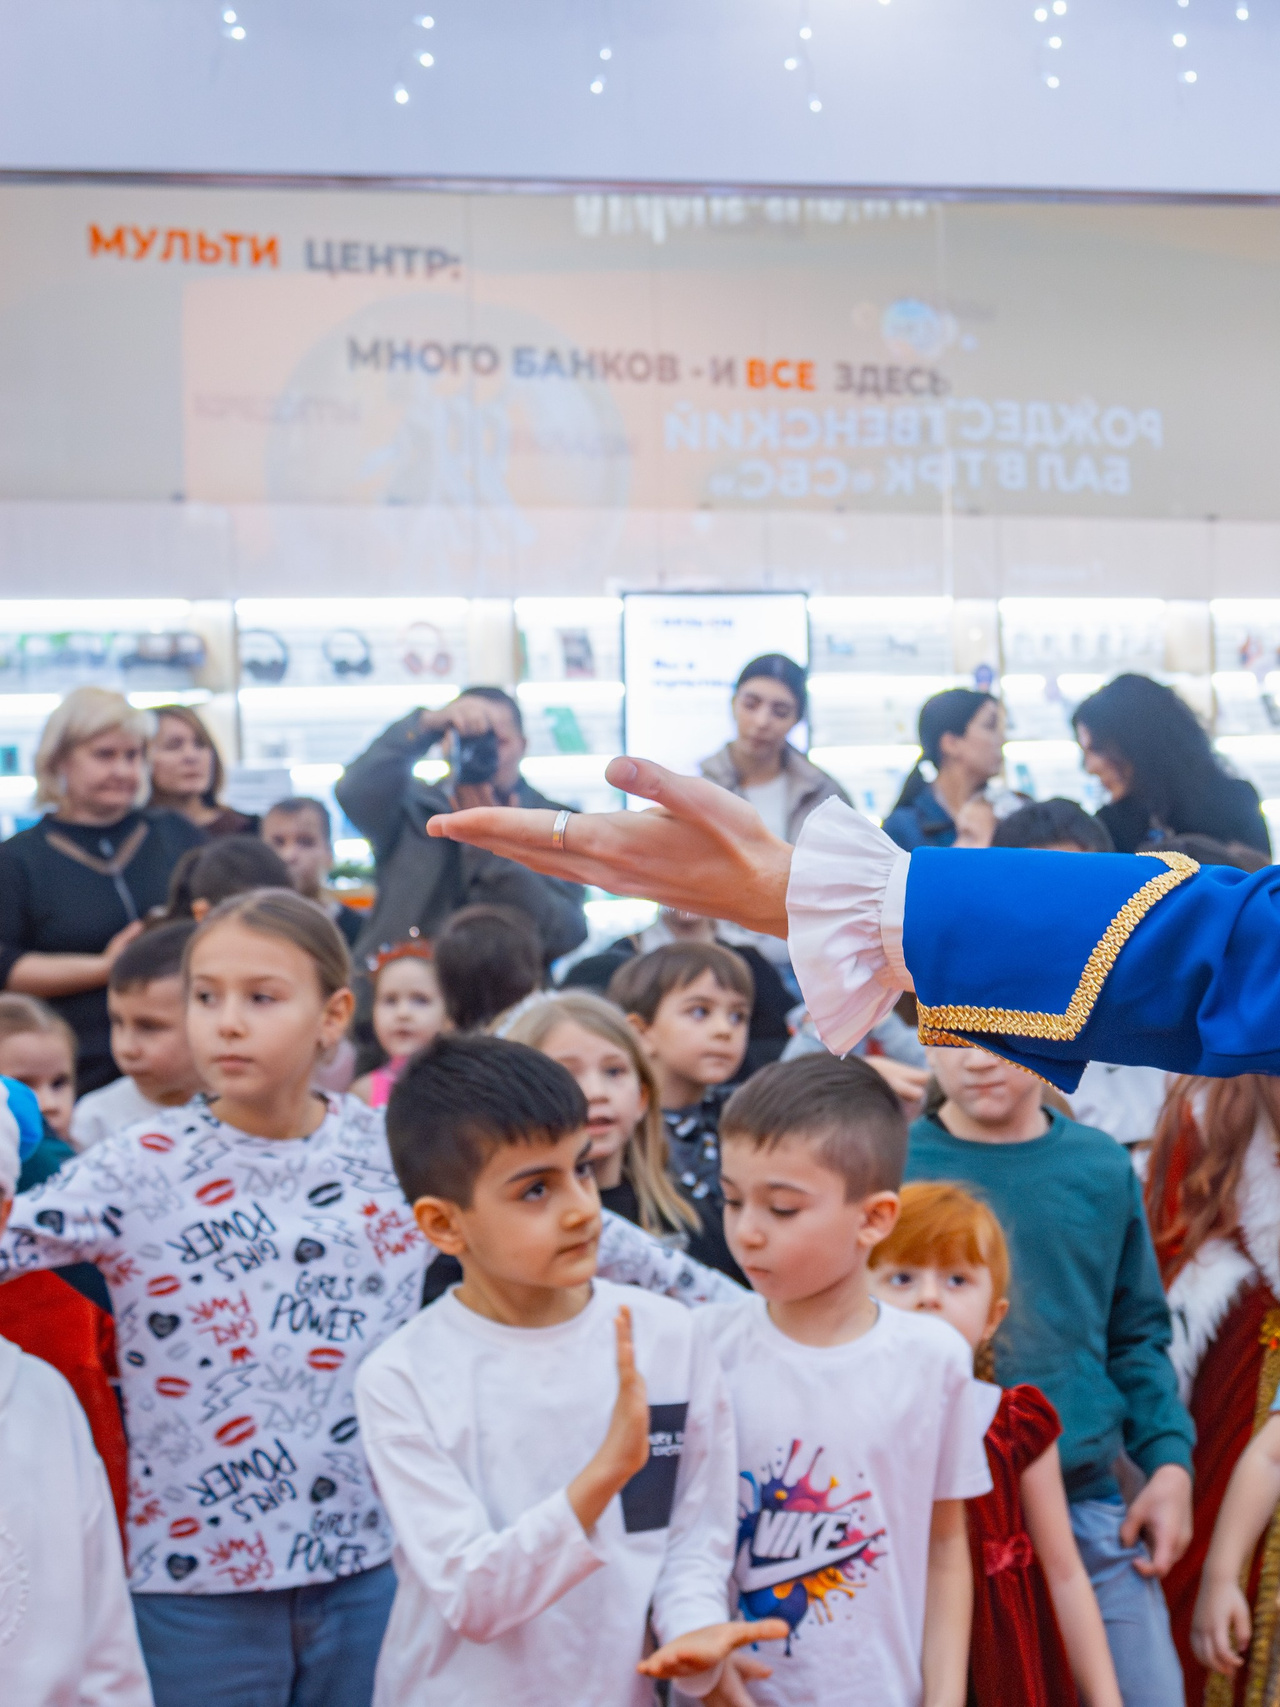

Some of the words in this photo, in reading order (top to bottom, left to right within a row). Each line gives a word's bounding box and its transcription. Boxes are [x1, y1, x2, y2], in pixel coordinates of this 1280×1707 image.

[88, 223, 280, 268] МУЛЬТИ
[304, 237, 462, 279] ЦЕНТР:
[347, 336, 499, 377] МНОГО
[511, 345, 680, 384] БАНКОВ
[746, 358, 816, 391] ВСЕ
[833, 360, 952, 398] ЗДЕСЬ
[166, 1200, 278, 1264] POWER
[213, 1238, 280, 1283] GIRLS
[296, 1270, 355, 1301] GIRLS
[270, 1293, 368, 1342] POWER
[186, 1436, 298, 1507] POWER
[231, 1478, 298, 1524] GIRLS
[753, 1508, 852, 1559] NIKE
